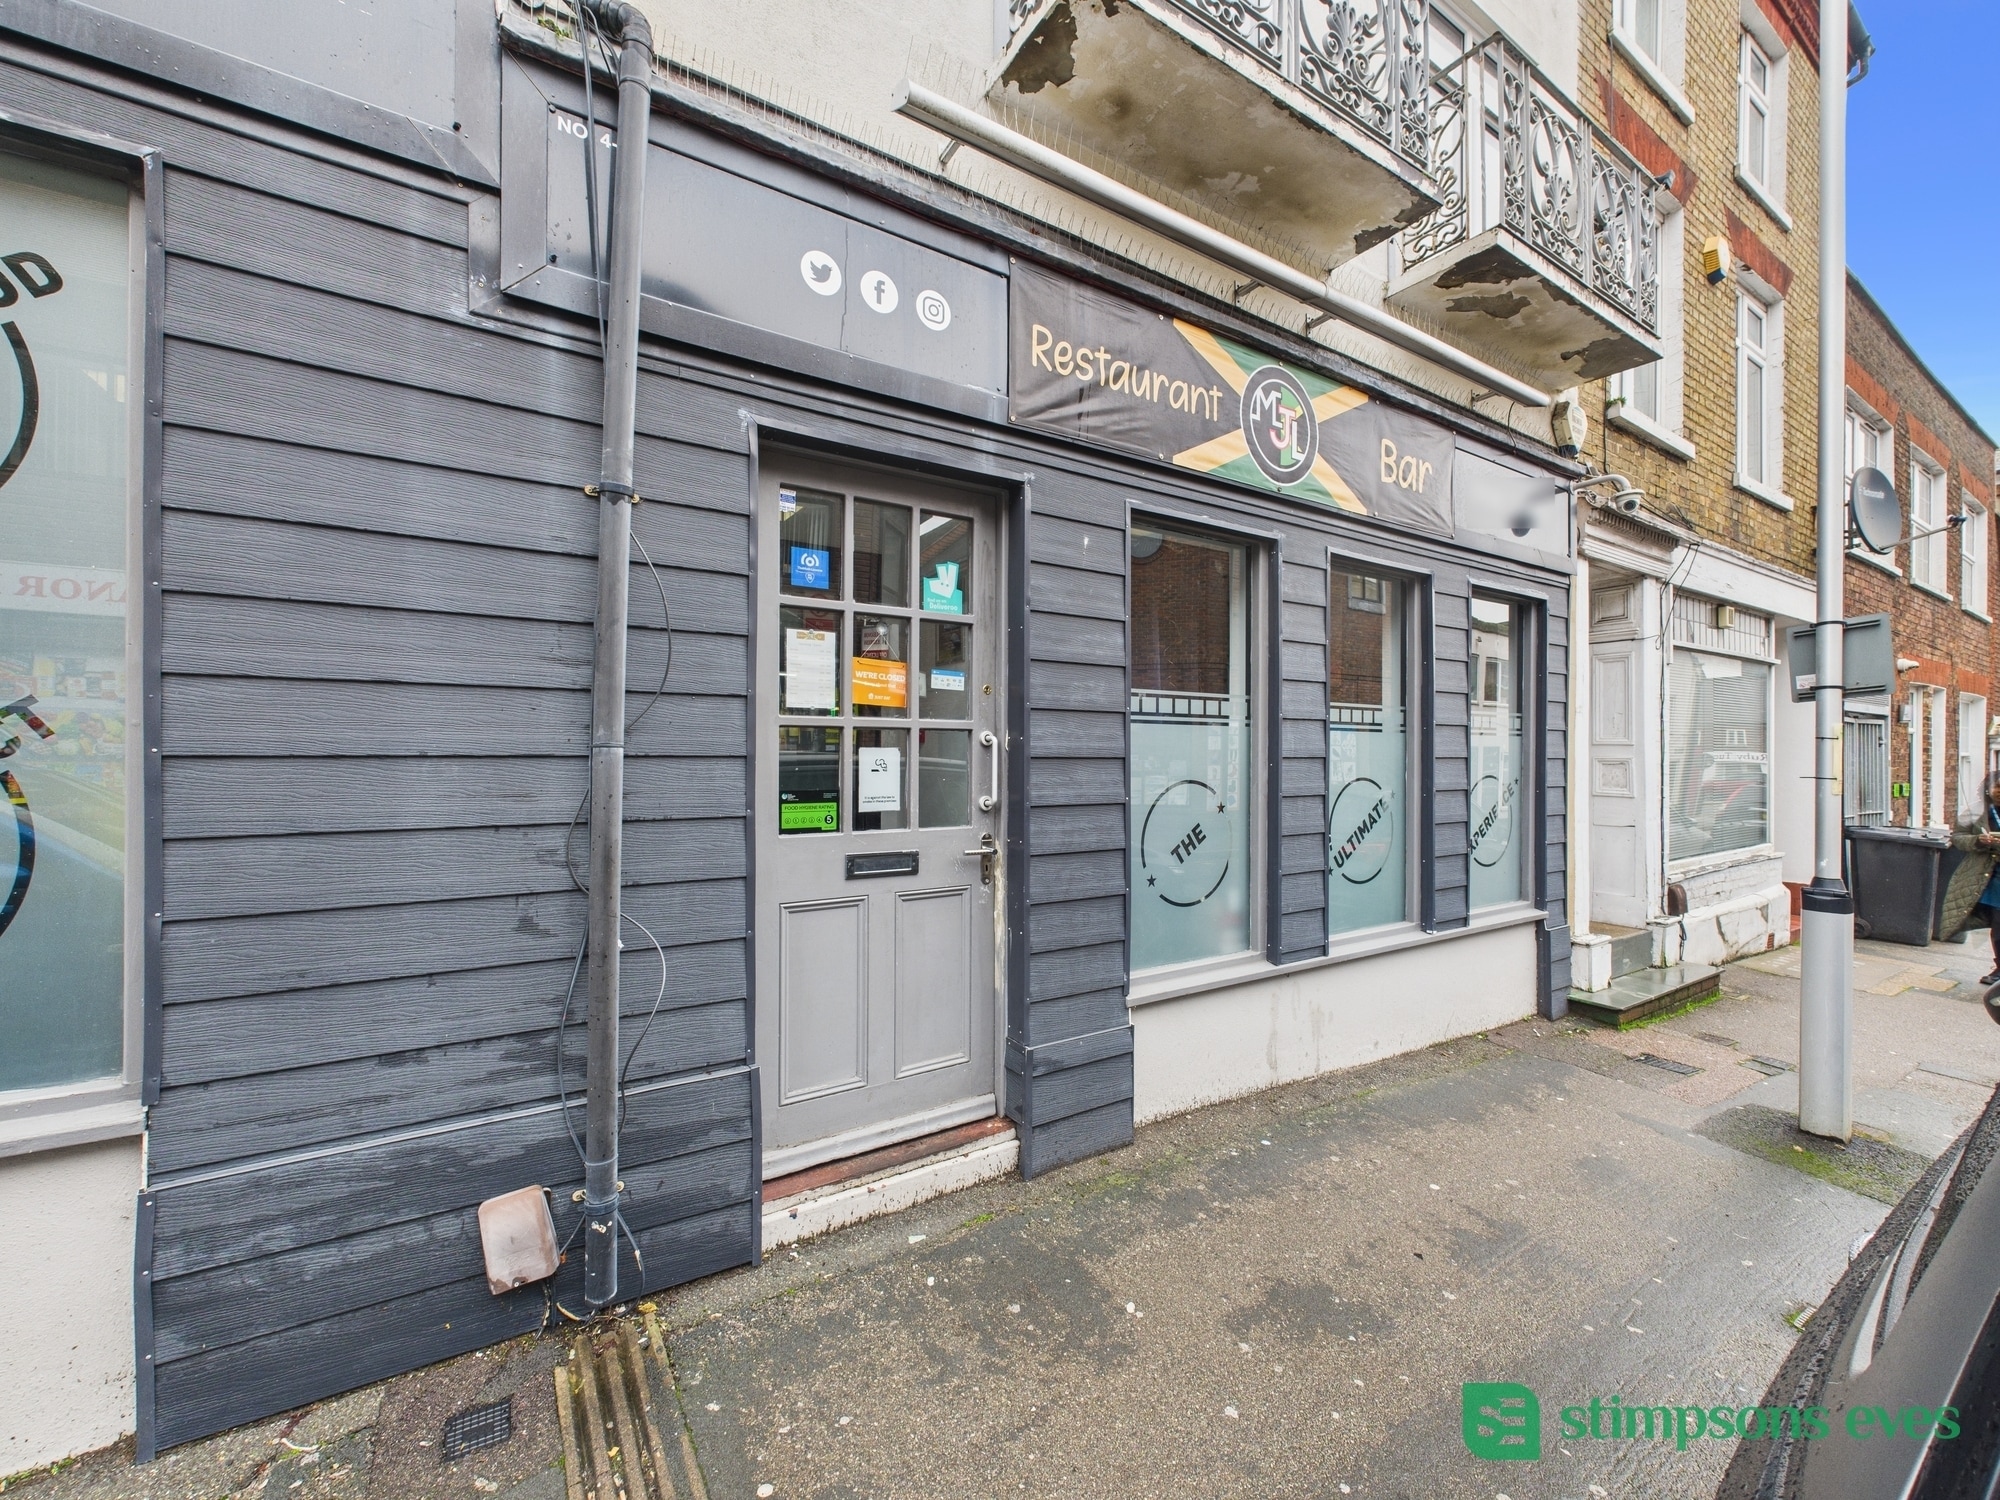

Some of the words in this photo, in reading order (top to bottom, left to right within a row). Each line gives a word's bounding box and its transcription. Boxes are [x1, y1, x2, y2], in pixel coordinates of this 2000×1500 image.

[557, 116, 588, 139] NO
[1032, 324, 1223, 422] Restaurant
[1381, 438, 1433, 493] Bar
[929, 602, 958, 611] Deliveroo
[855, 671, 878, 679] WE'RE
[878, 673, 906, 682] CLOSED
[1170, 823, 1207, 864] THE
[1333, 796, 1390, 869] ULTIMATE
